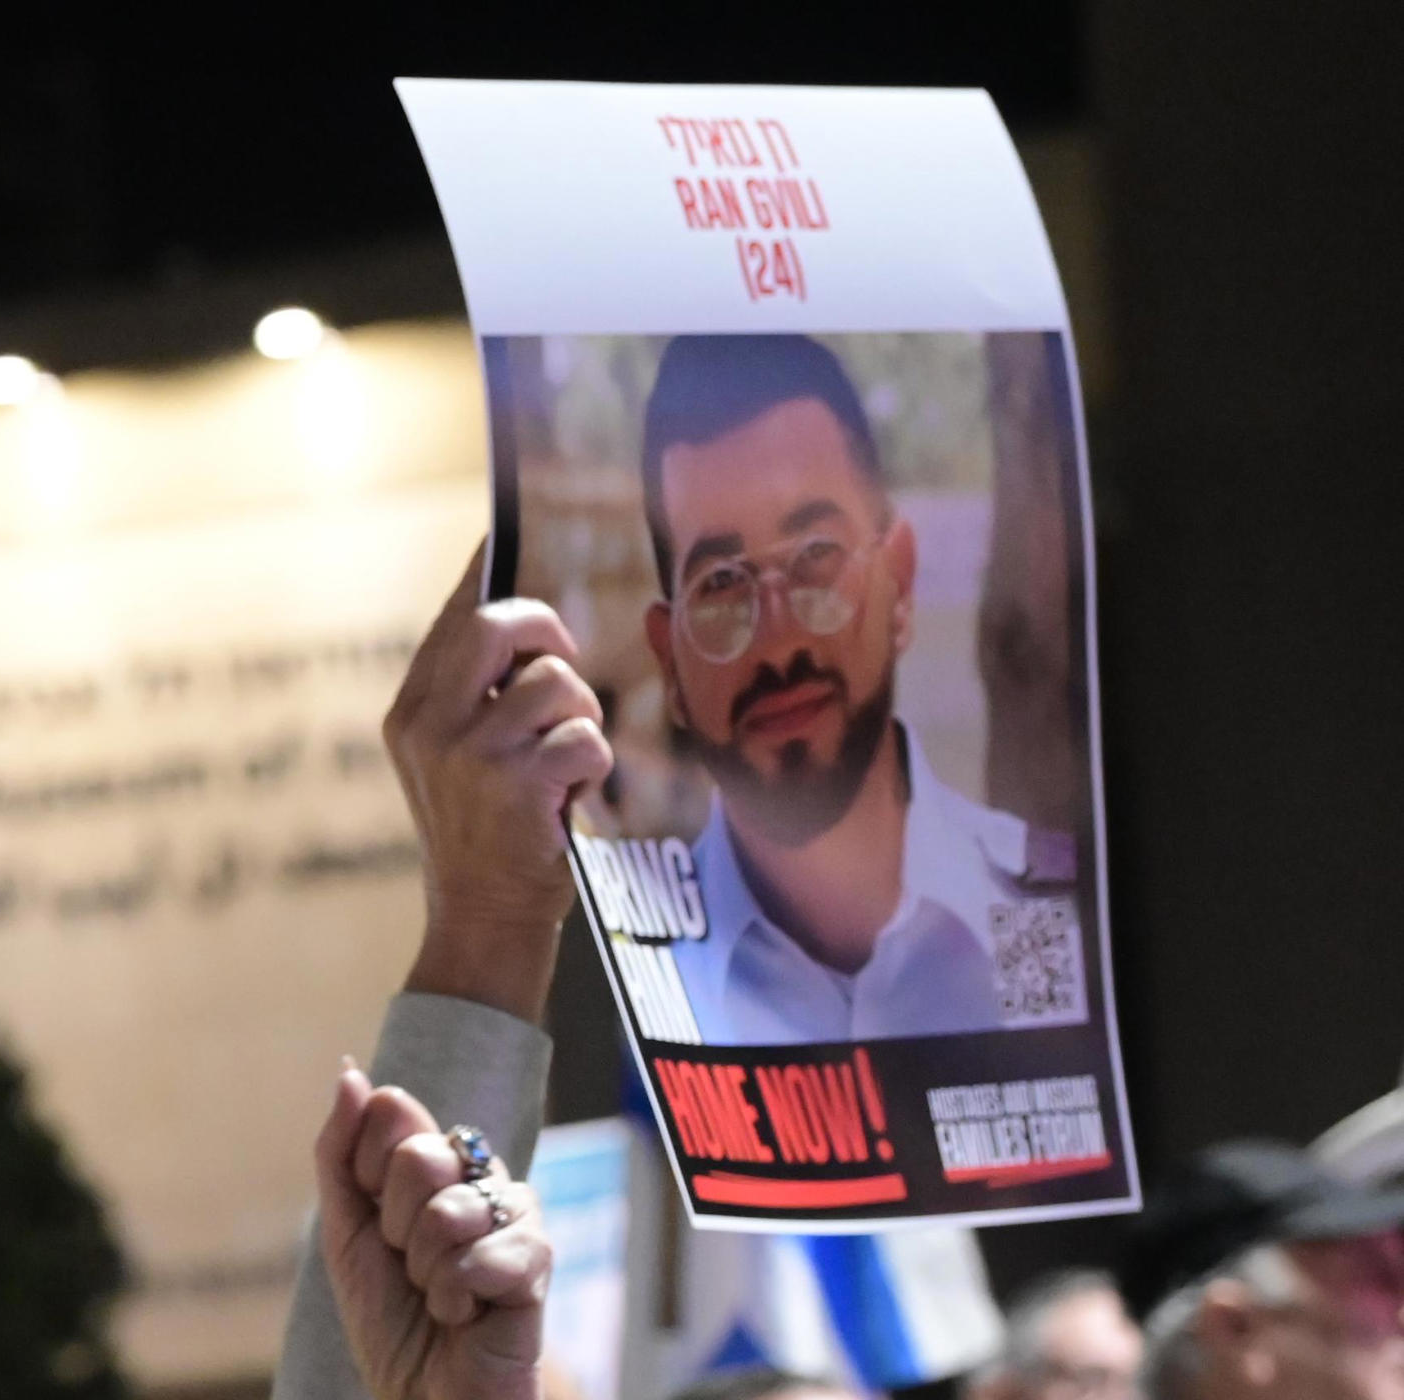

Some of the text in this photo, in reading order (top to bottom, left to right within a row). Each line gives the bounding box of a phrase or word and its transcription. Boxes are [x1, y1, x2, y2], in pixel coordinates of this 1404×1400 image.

[674, 177, 831, 231] RAN GVILI
[735, 233, 808, 304] (24)
[571, 831, 707, 941] BRING
[654, 1046, 895, 1164] HOME NOW!
